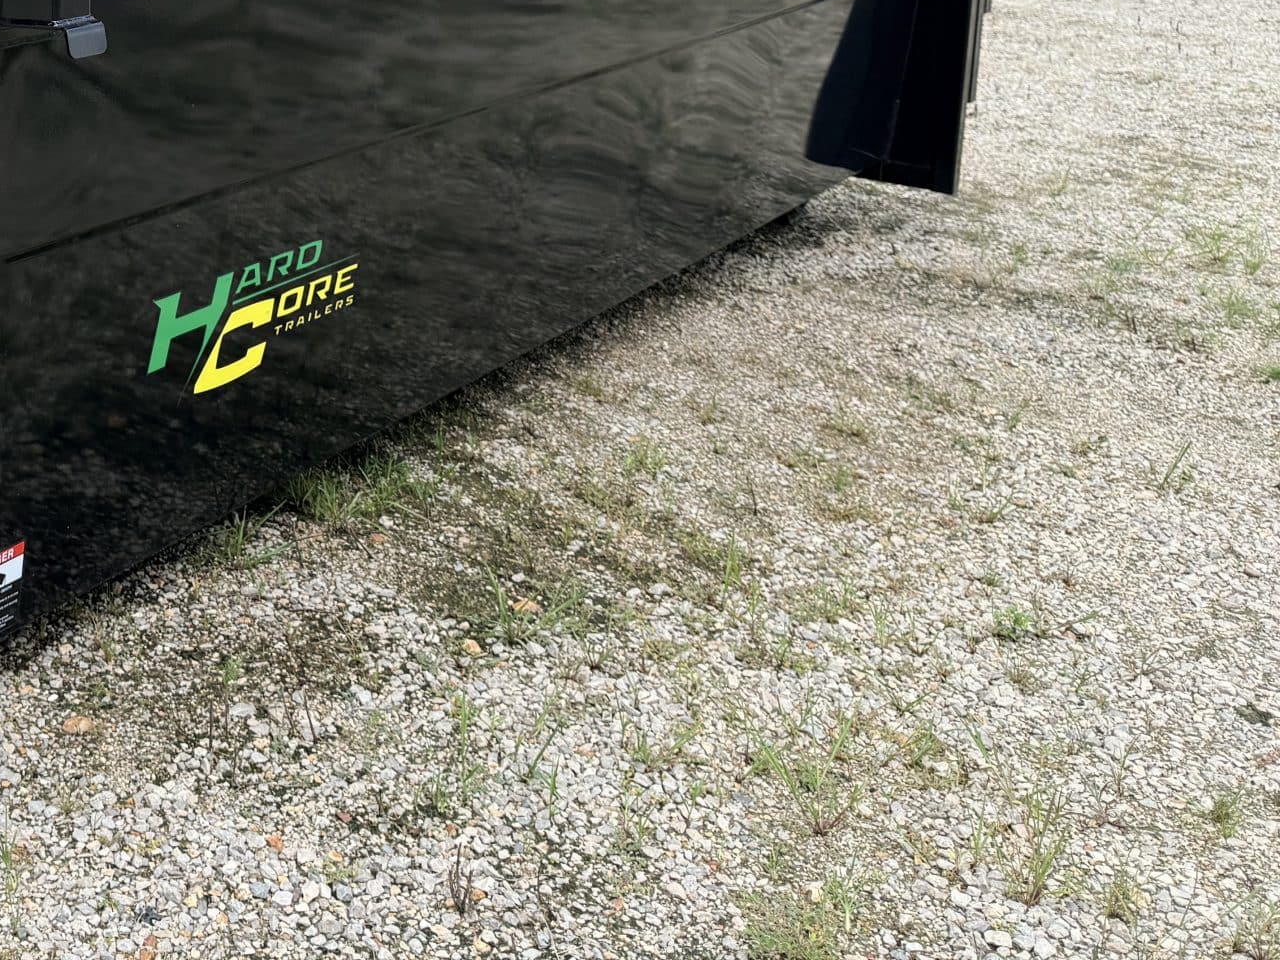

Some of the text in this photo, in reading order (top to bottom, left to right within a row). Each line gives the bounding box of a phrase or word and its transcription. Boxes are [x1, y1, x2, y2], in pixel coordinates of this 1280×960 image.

[147, 239, 323, 376] HARD
[193, 263, 359, 395] CORE
[273, 294, 355, 336] TRAILERS
